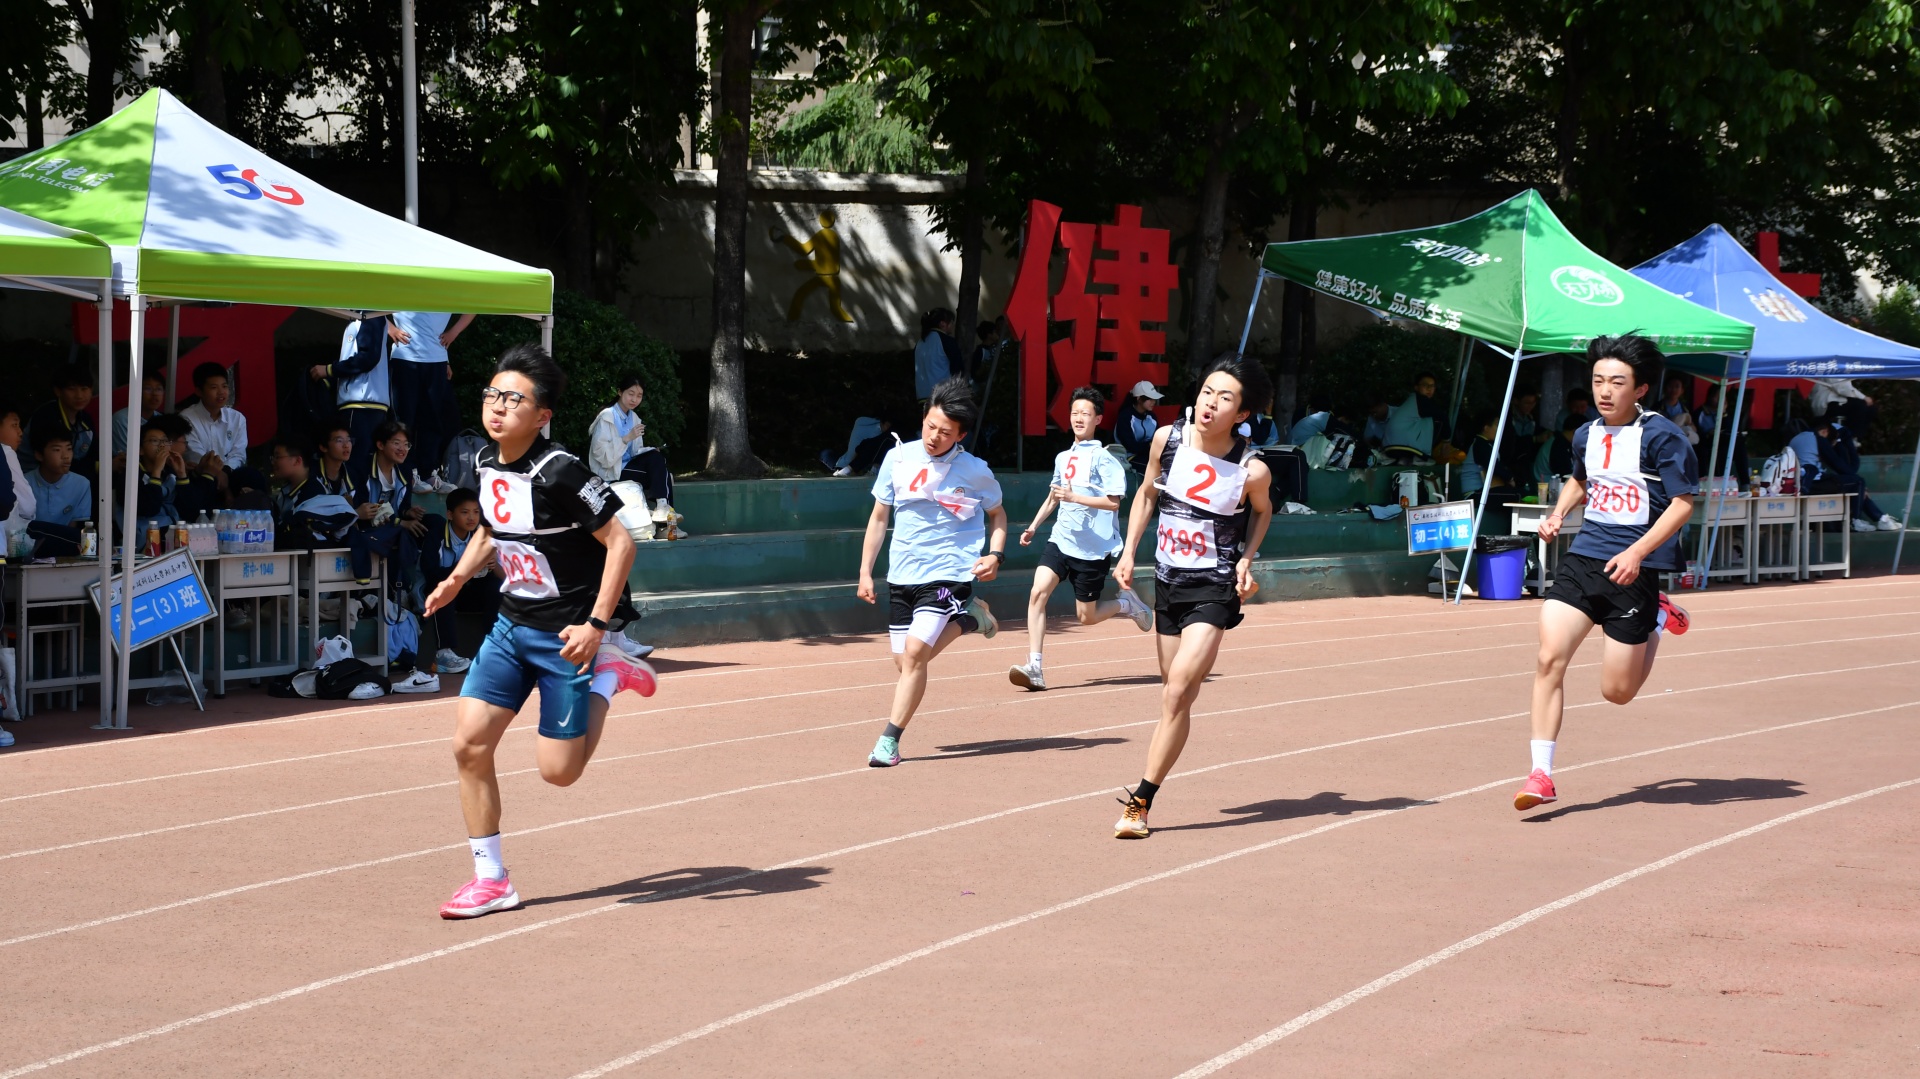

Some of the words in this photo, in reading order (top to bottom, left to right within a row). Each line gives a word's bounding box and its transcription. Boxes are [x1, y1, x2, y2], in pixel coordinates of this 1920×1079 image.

[36, 175, 90, 193] TELECOM
[205, 164, 304, 206] 5G
[1315, 269, 1382, 305] 健康好水
[1387, 292, 1462, 331] 品质生活
[1064, 456, 1079, 480] 5
[1601, 433, 1613, 470] 1
[909, 468, 929, 493] 4
[1185, 463, 1217, 505] 2
[491, 478, 512, 524] 3
[1414, 524, 1470, 544] 初二(4)班
[499, 552, 543, 585] 293
